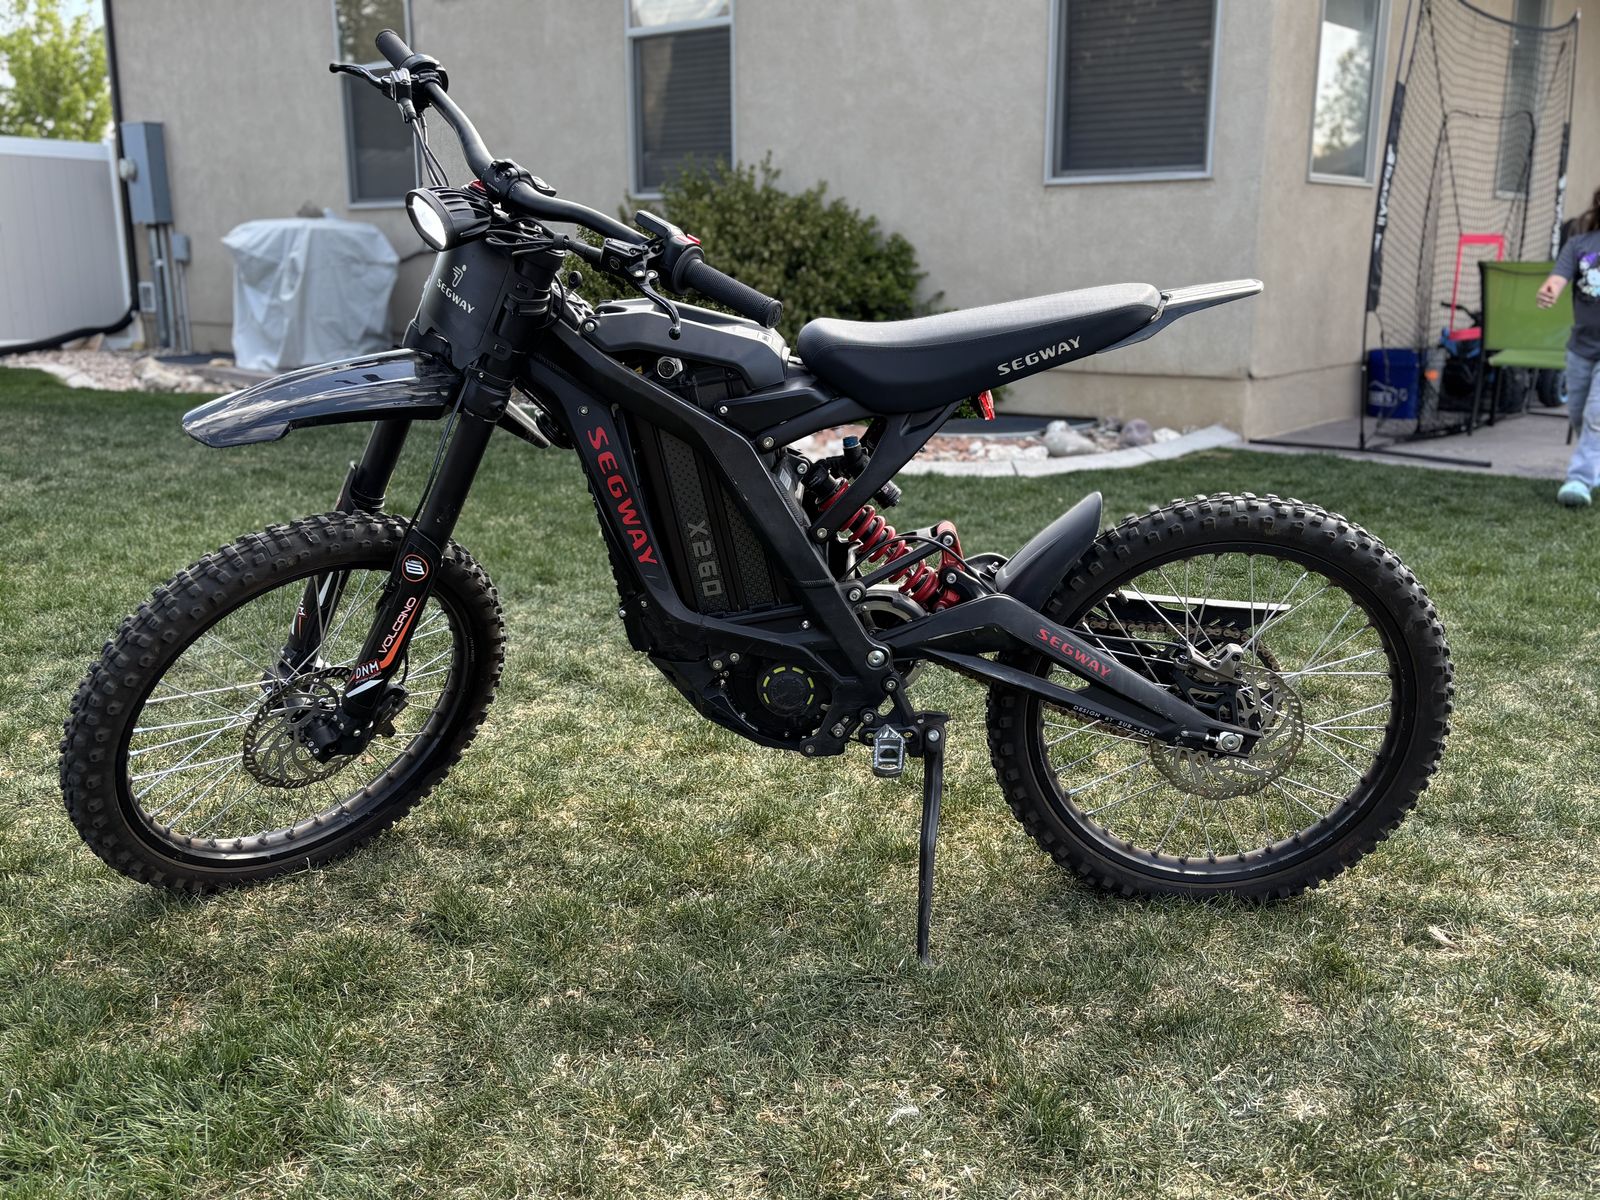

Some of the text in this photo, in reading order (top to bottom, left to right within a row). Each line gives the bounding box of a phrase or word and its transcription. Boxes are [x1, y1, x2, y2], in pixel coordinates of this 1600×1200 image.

[436, 278, 475, 314] SEGWAY
[997, 335, 1081, 376] SEGWAY
[587, 426, 658, 565] SEGWAY
[687, 520, 723, 597] X260
[378, 596, 417, 654] VOLCANO
[355, 660, 379, 679] DNM
[1036, 628, 1112, 678] SEGWAY
[1072, 705, 1101, 718] DESIGN
